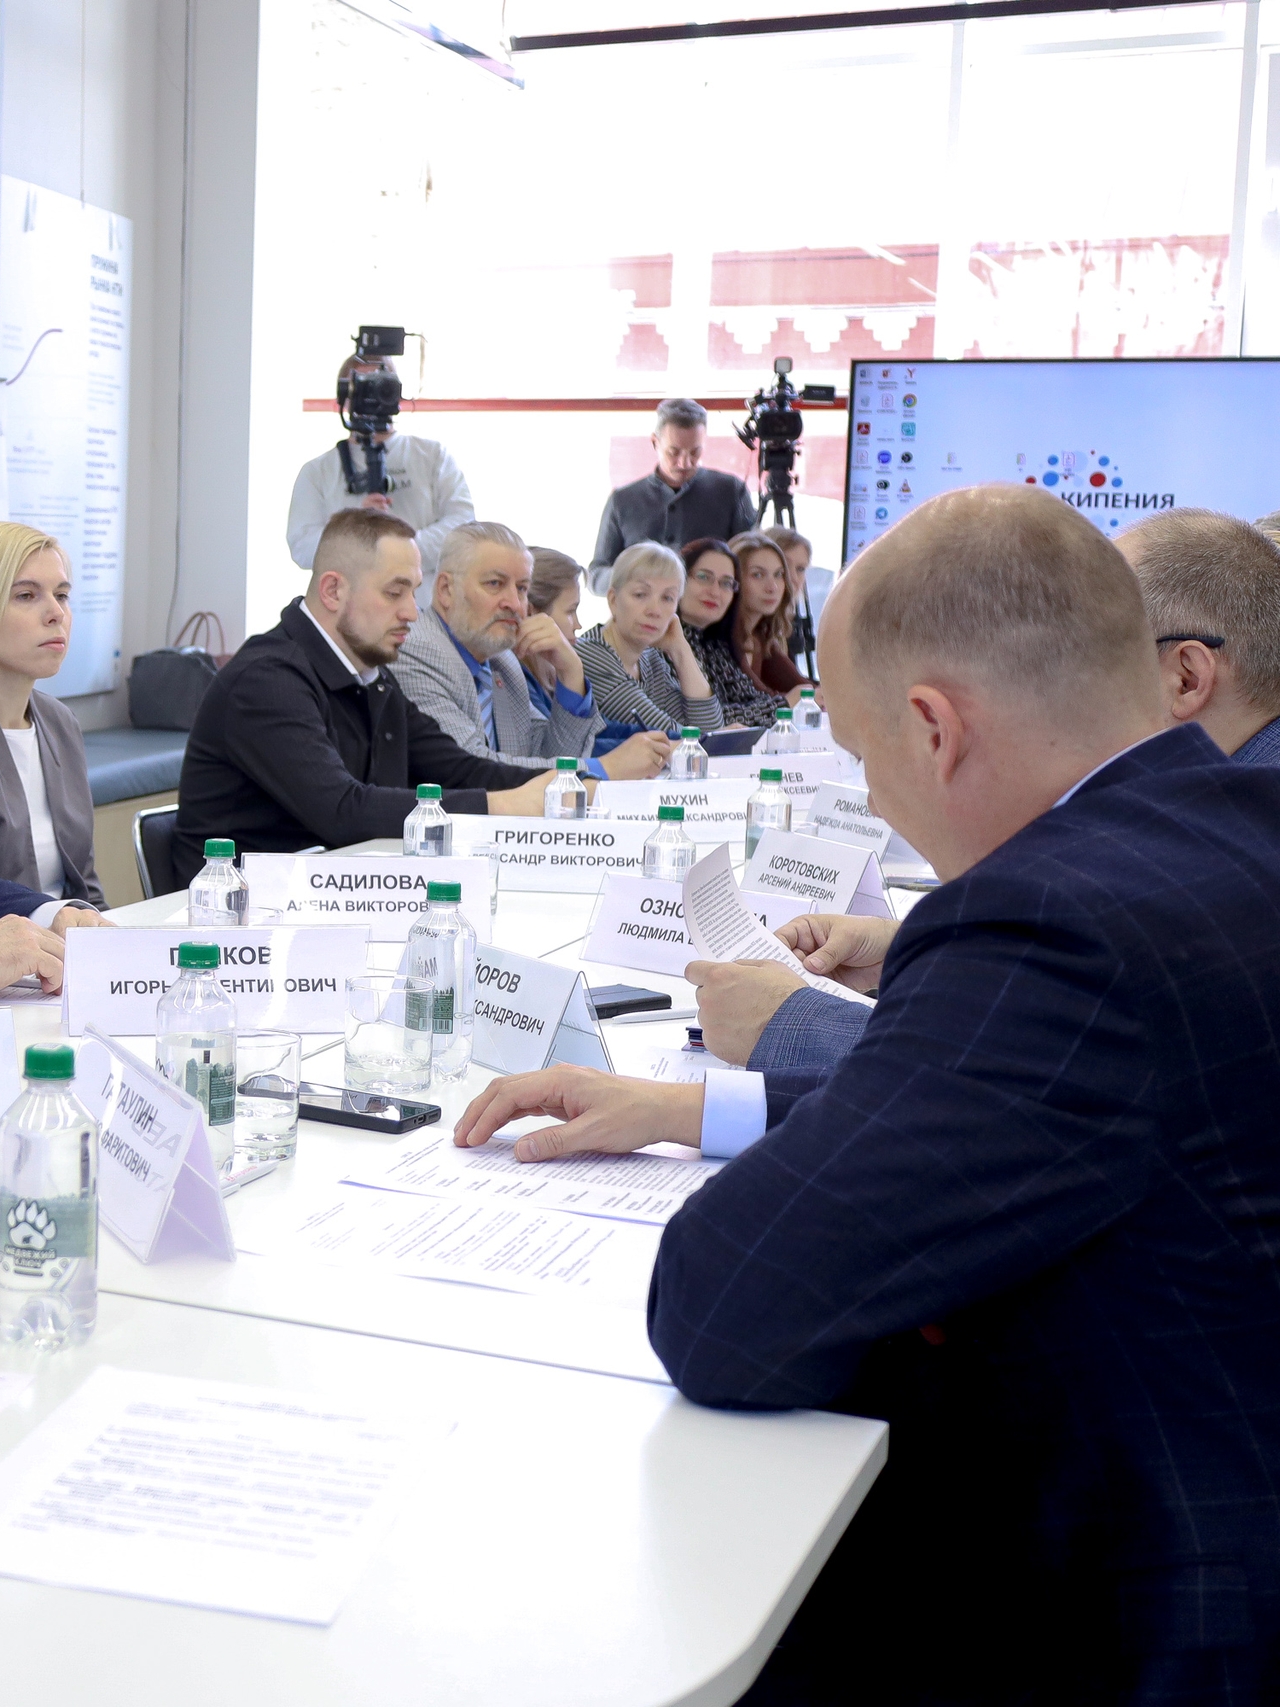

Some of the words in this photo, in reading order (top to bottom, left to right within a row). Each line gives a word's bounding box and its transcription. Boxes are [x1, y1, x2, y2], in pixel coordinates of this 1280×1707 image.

[1061, 491, 1175, 509] КИПЕНИЯ
[659, 794, 708, 806] МУХИН
[834, 798, 876, 819] РОМАНОВ
[617, 813, 659, 821] МИХАИ
[494, 830, 615, 847] ГРИГОРЕНКО
[769, 854, 840, 884] КОРОТОВСКИХ
[310, 874, 427, 892] САДИЛОВА
[758, 872, 792, 890] АРСЕНИЙ
[790, 881, 836, 902] АНДРЕЕВИЧ
[345, 900, 430, 913] ВИКТОРОВ
[617, 922, 684, 944] ЛЮДМИЛА
[110, 980, 171, 995] ИГОРЬ
